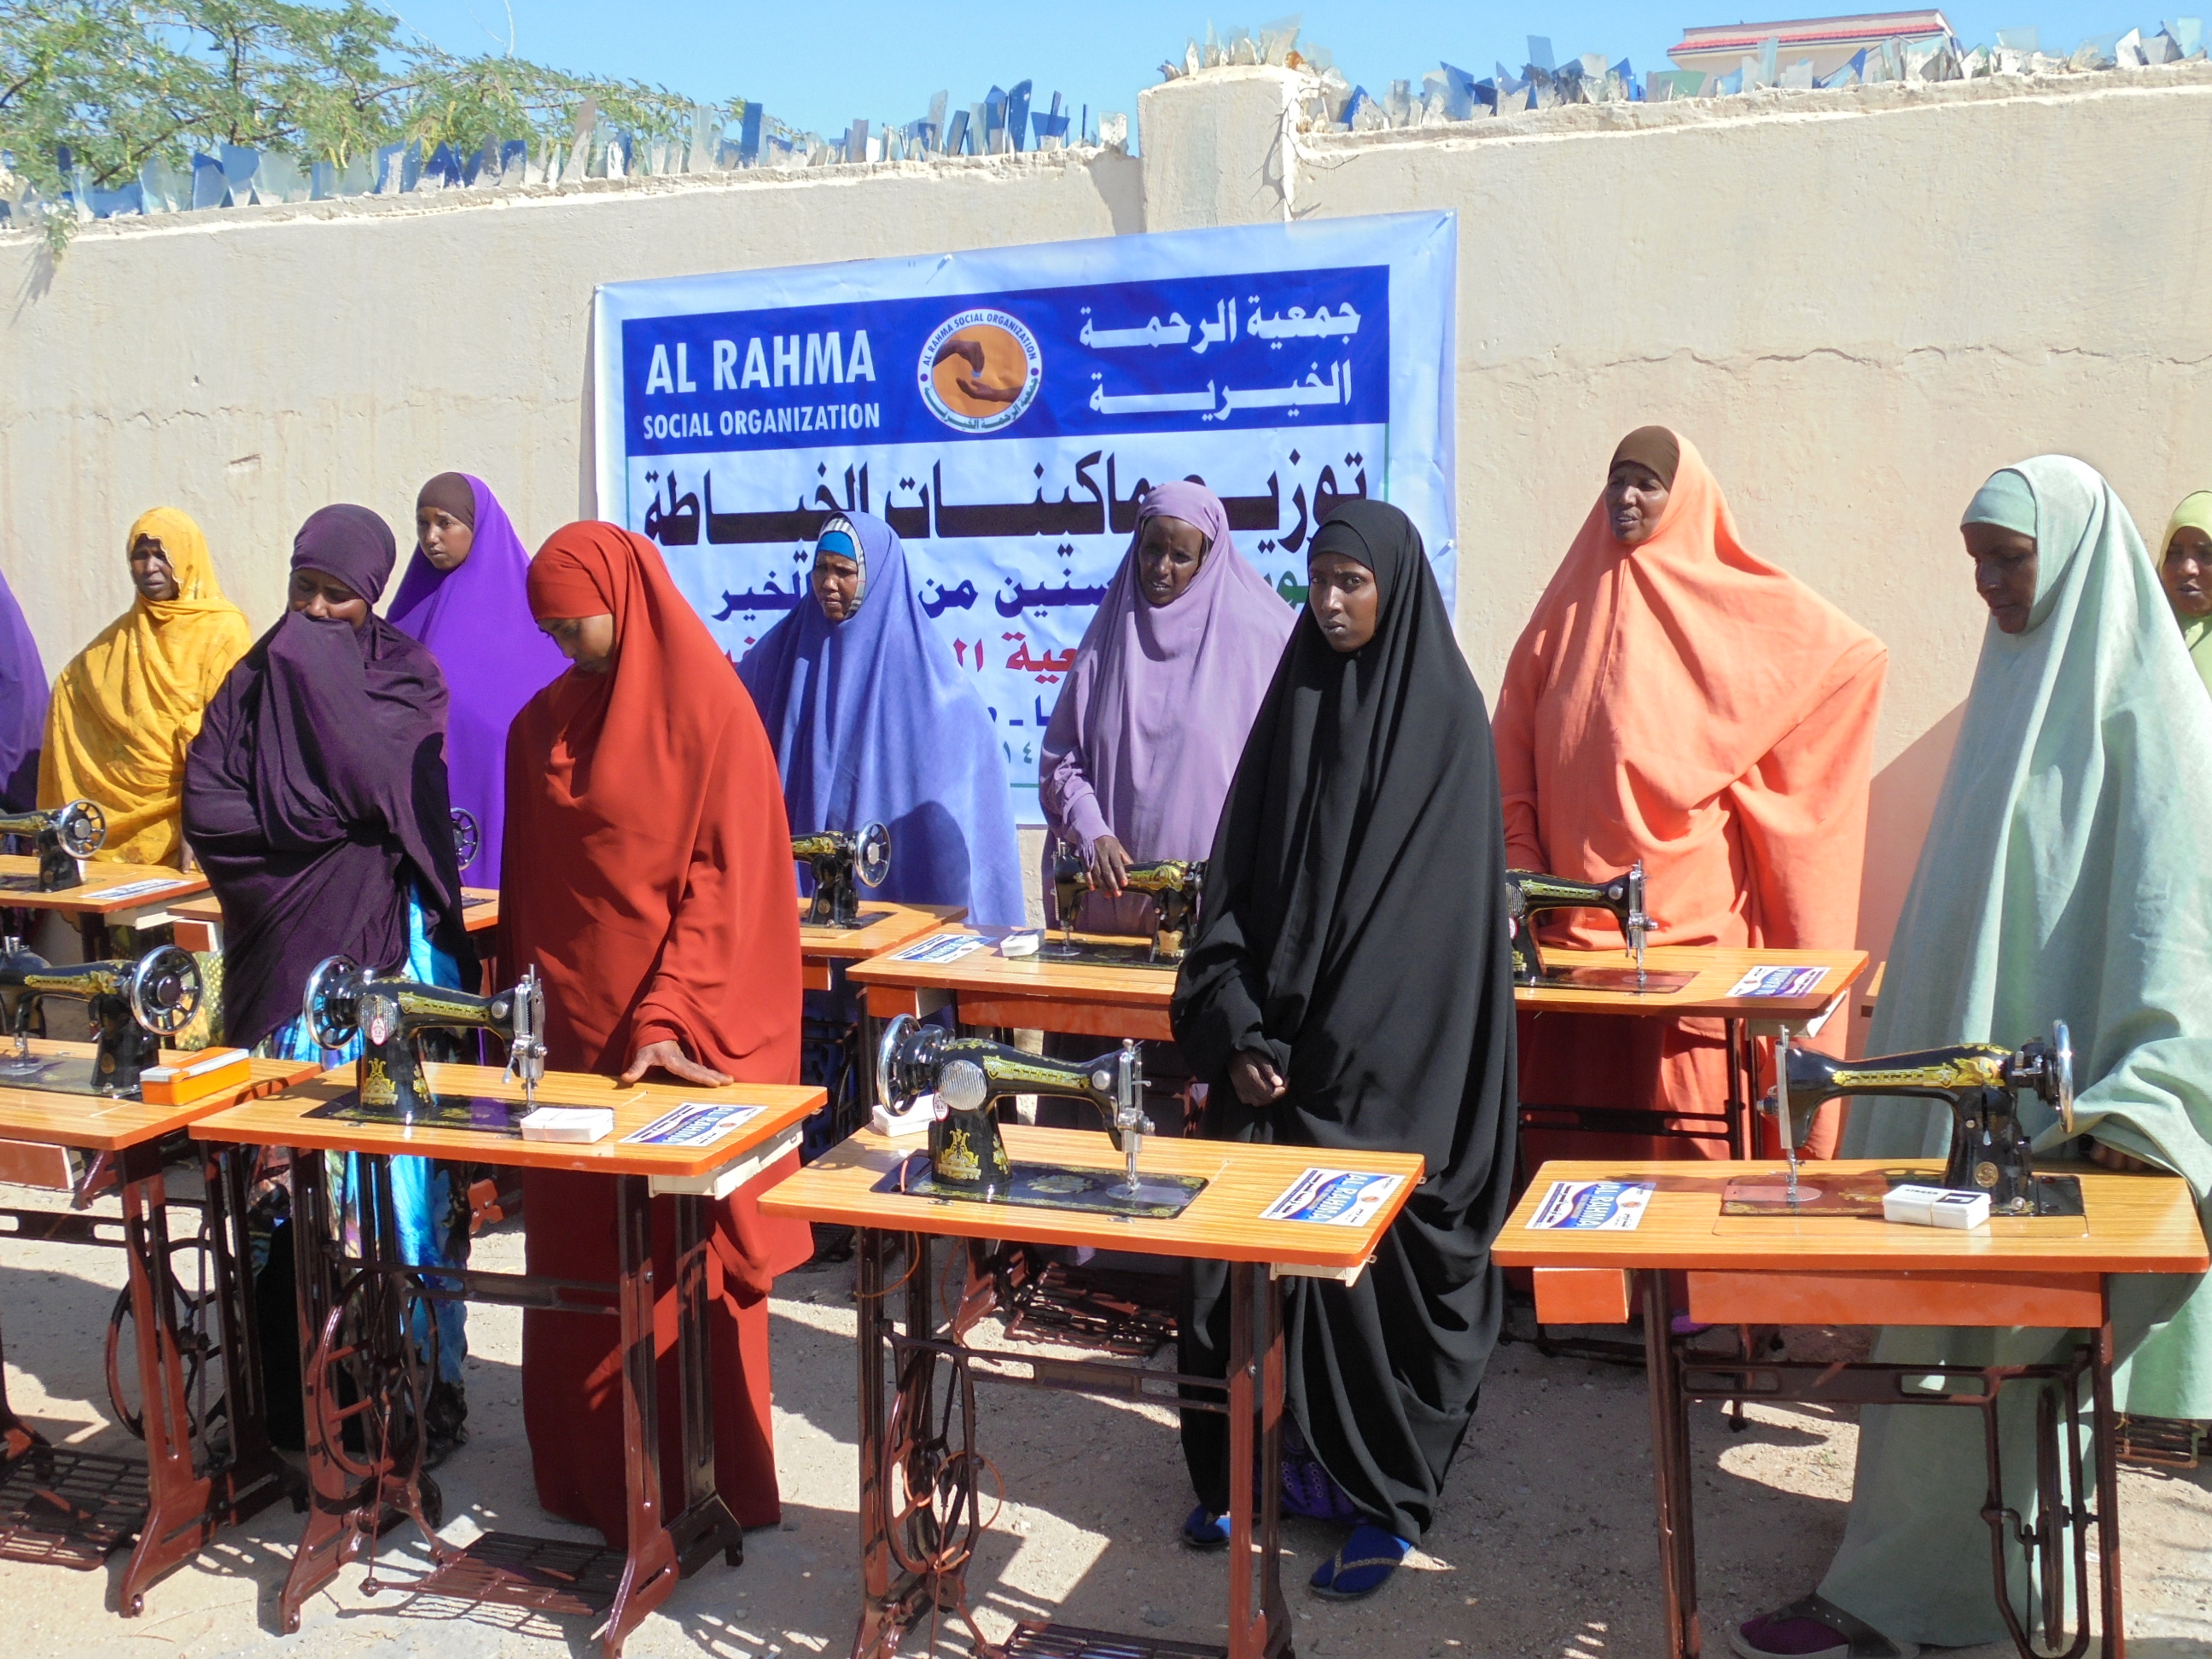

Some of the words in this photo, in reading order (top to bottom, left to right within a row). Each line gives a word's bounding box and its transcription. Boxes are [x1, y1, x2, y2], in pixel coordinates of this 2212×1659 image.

[923, 355, 933, 367] AL
[928, 323, 954, 352] RAHMA
[954, 312, 984, 328] SOCIAL
[987, 313, 1037, 360] ORGANIZATION
[1079, 296, 1237, 354] الرحمة
[1247, 294, 1361, 351] جمعية
[645, 342, 696, 395] AL
[713, 329, 876, 391] RAHMA
[924, 384, 980, 430] الخيرية
[1089, 358, 1352, 422] الخيرية
[643, 412, 713, 440] SOCIAL
[719, 402, 880, 436] ORGANIZATION
[981, 404, 1022, 429] الرحمة
[644, 461, 870, 563] الخياطة
[1183, 448, 1367, 554] توزي
[711, 569, 813, 622] لخير
[918, 578, 979, 620] من
[1857, 1071, 1920, 1083] SINGER
[662, 1116, 719, 1143] RAHMA
[1342, 1173, 1369, 1186] AL
[1594, 1184, 1621, 1194] AL
[1309, 1187, 1354, 1221] RAHMA
[1577, 1196, 1615, 1227] RAHMA
